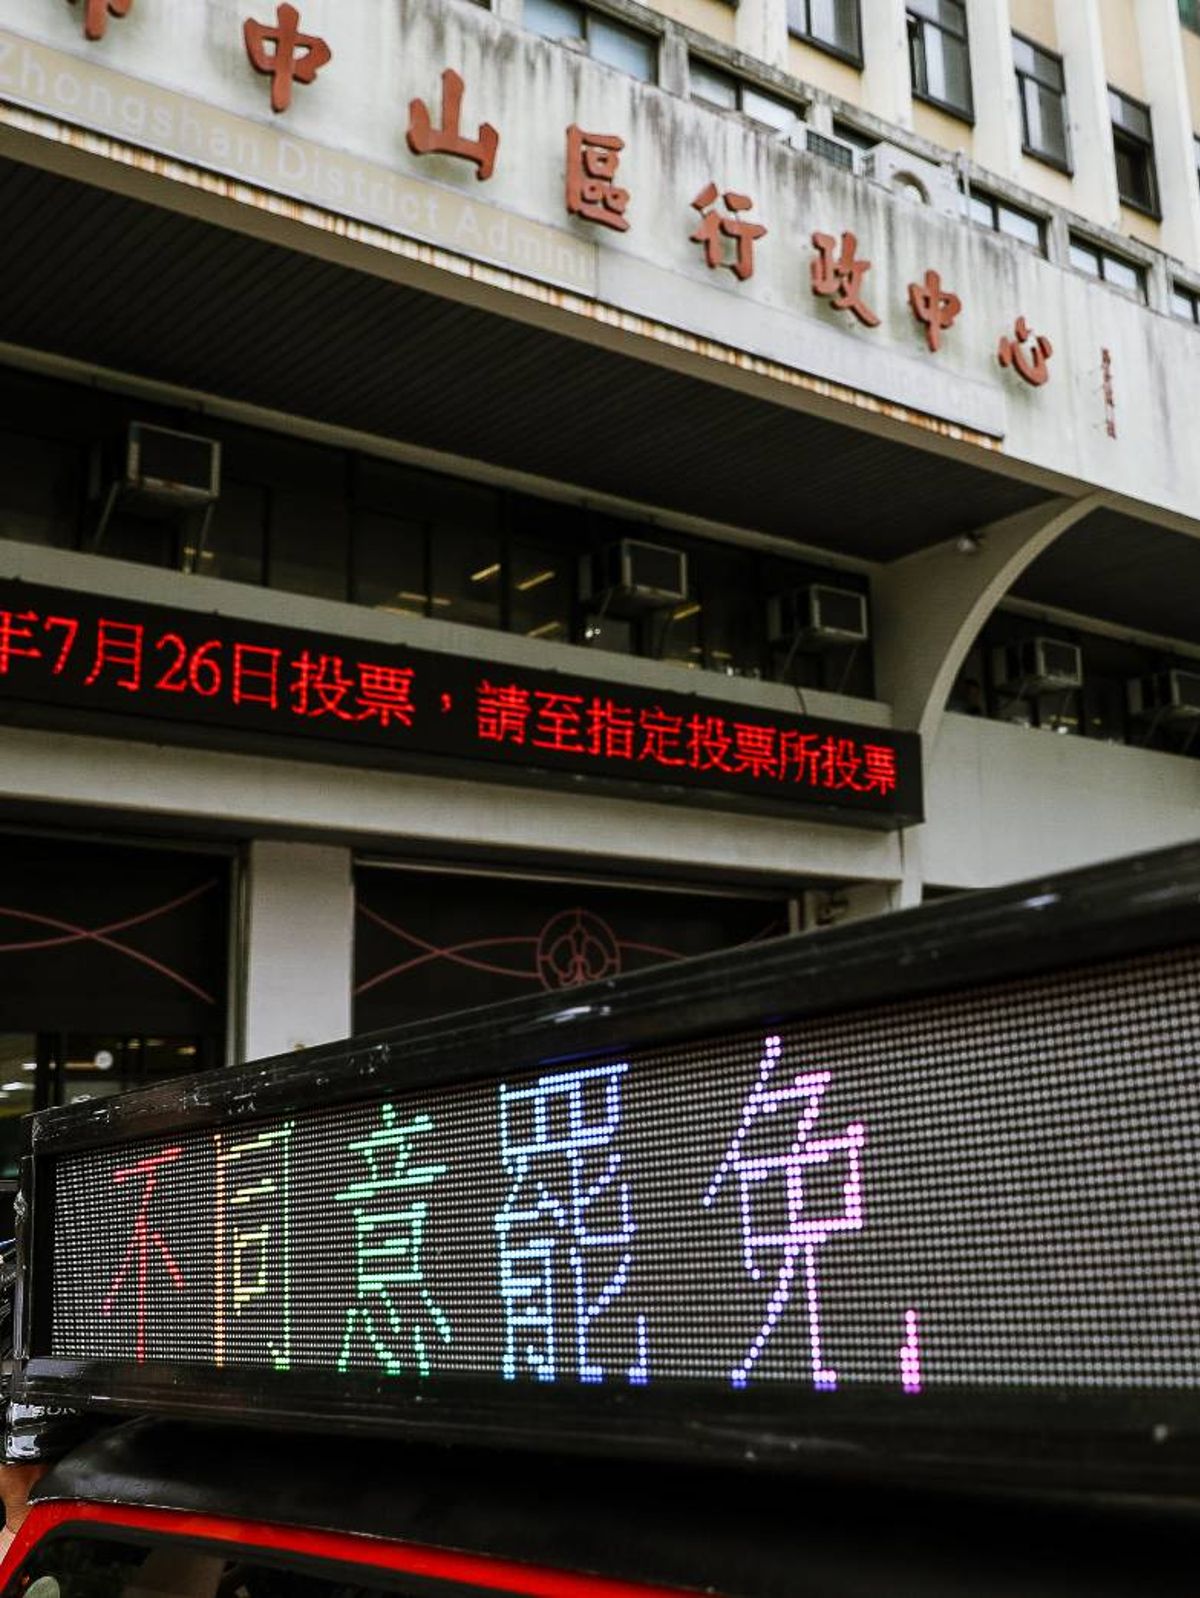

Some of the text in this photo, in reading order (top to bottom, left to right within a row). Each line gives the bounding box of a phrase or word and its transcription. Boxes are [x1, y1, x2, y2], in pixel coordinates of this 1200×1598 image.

[277, 136, 441, 233] District
[102, 1035, 921, 1393] 不同意罷免
